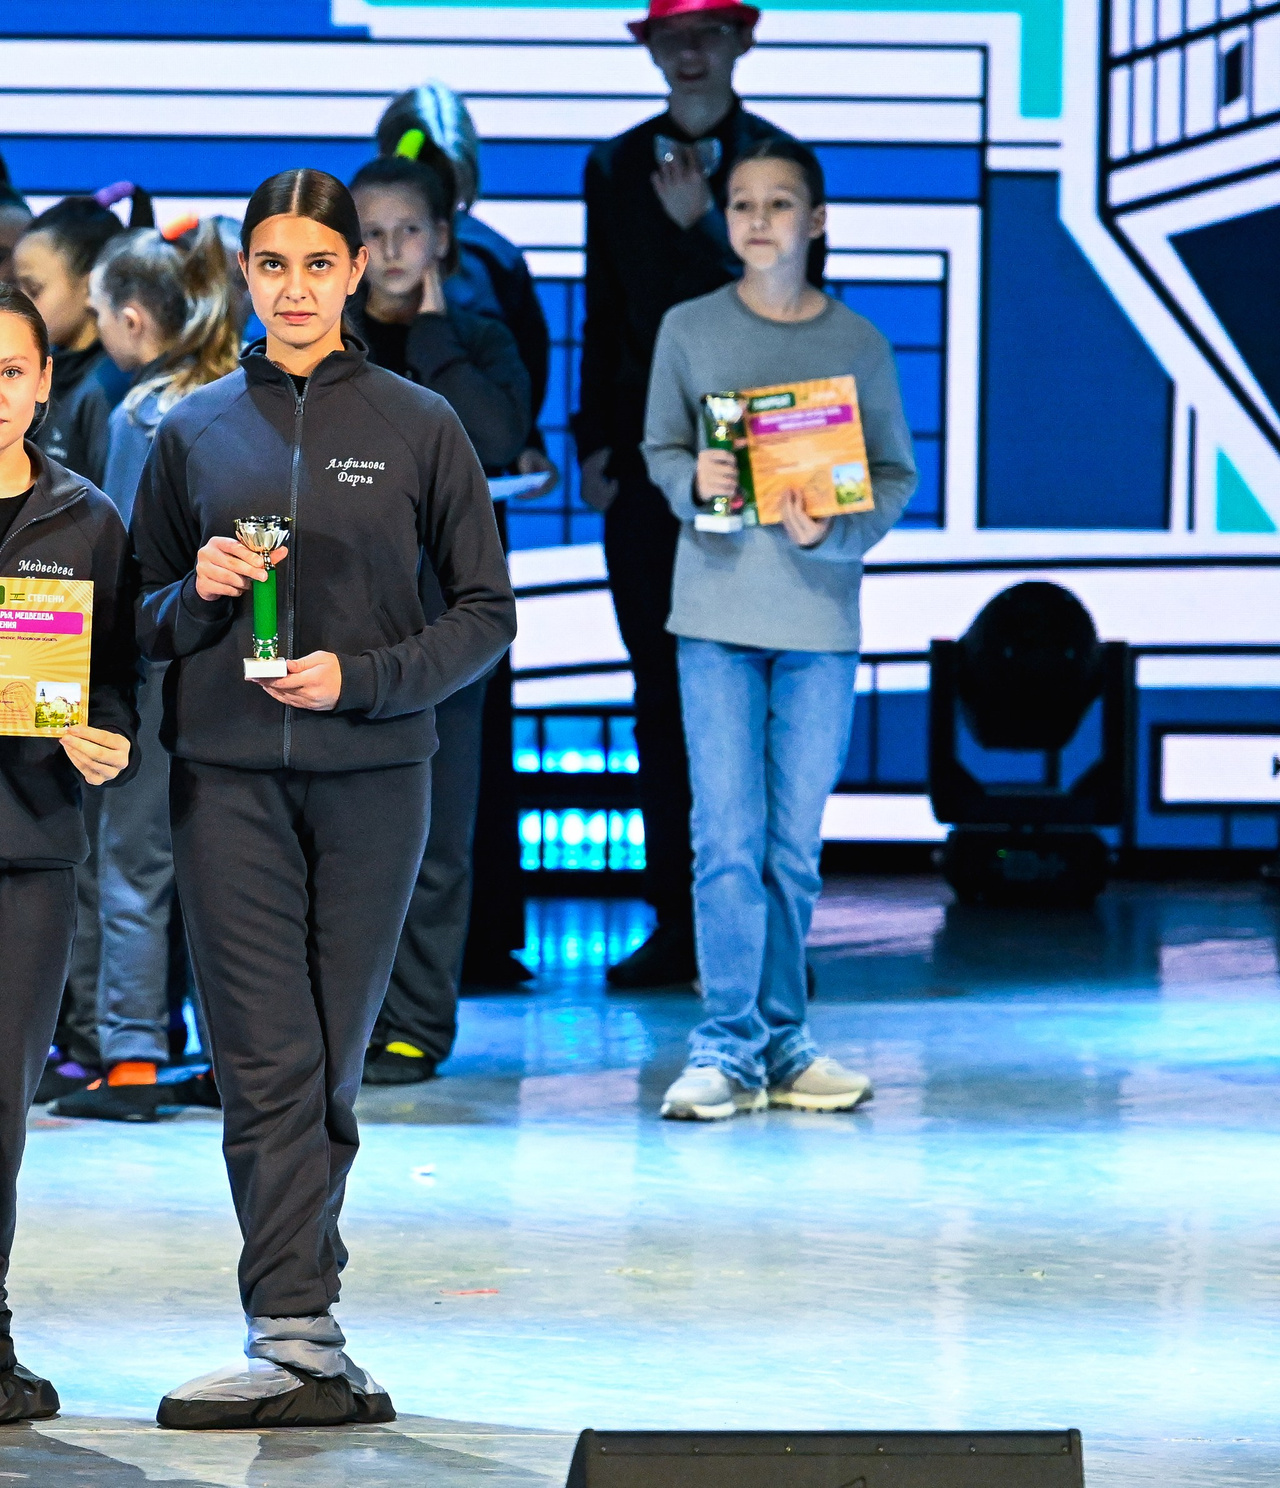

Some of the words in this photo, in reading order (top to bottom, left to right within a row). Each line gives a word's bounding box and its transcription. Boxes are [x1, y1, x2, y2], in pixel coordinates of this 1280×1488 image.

[325, 457, 386, 471] Алфимова
[337, 471, 374, 487] Дарья
[17, 559, 74, 577] Медведева
[28, 593, 65, 603] СТЕПЕНИ
[14, 611, 54, 621] МЕДВЕДЕВА
